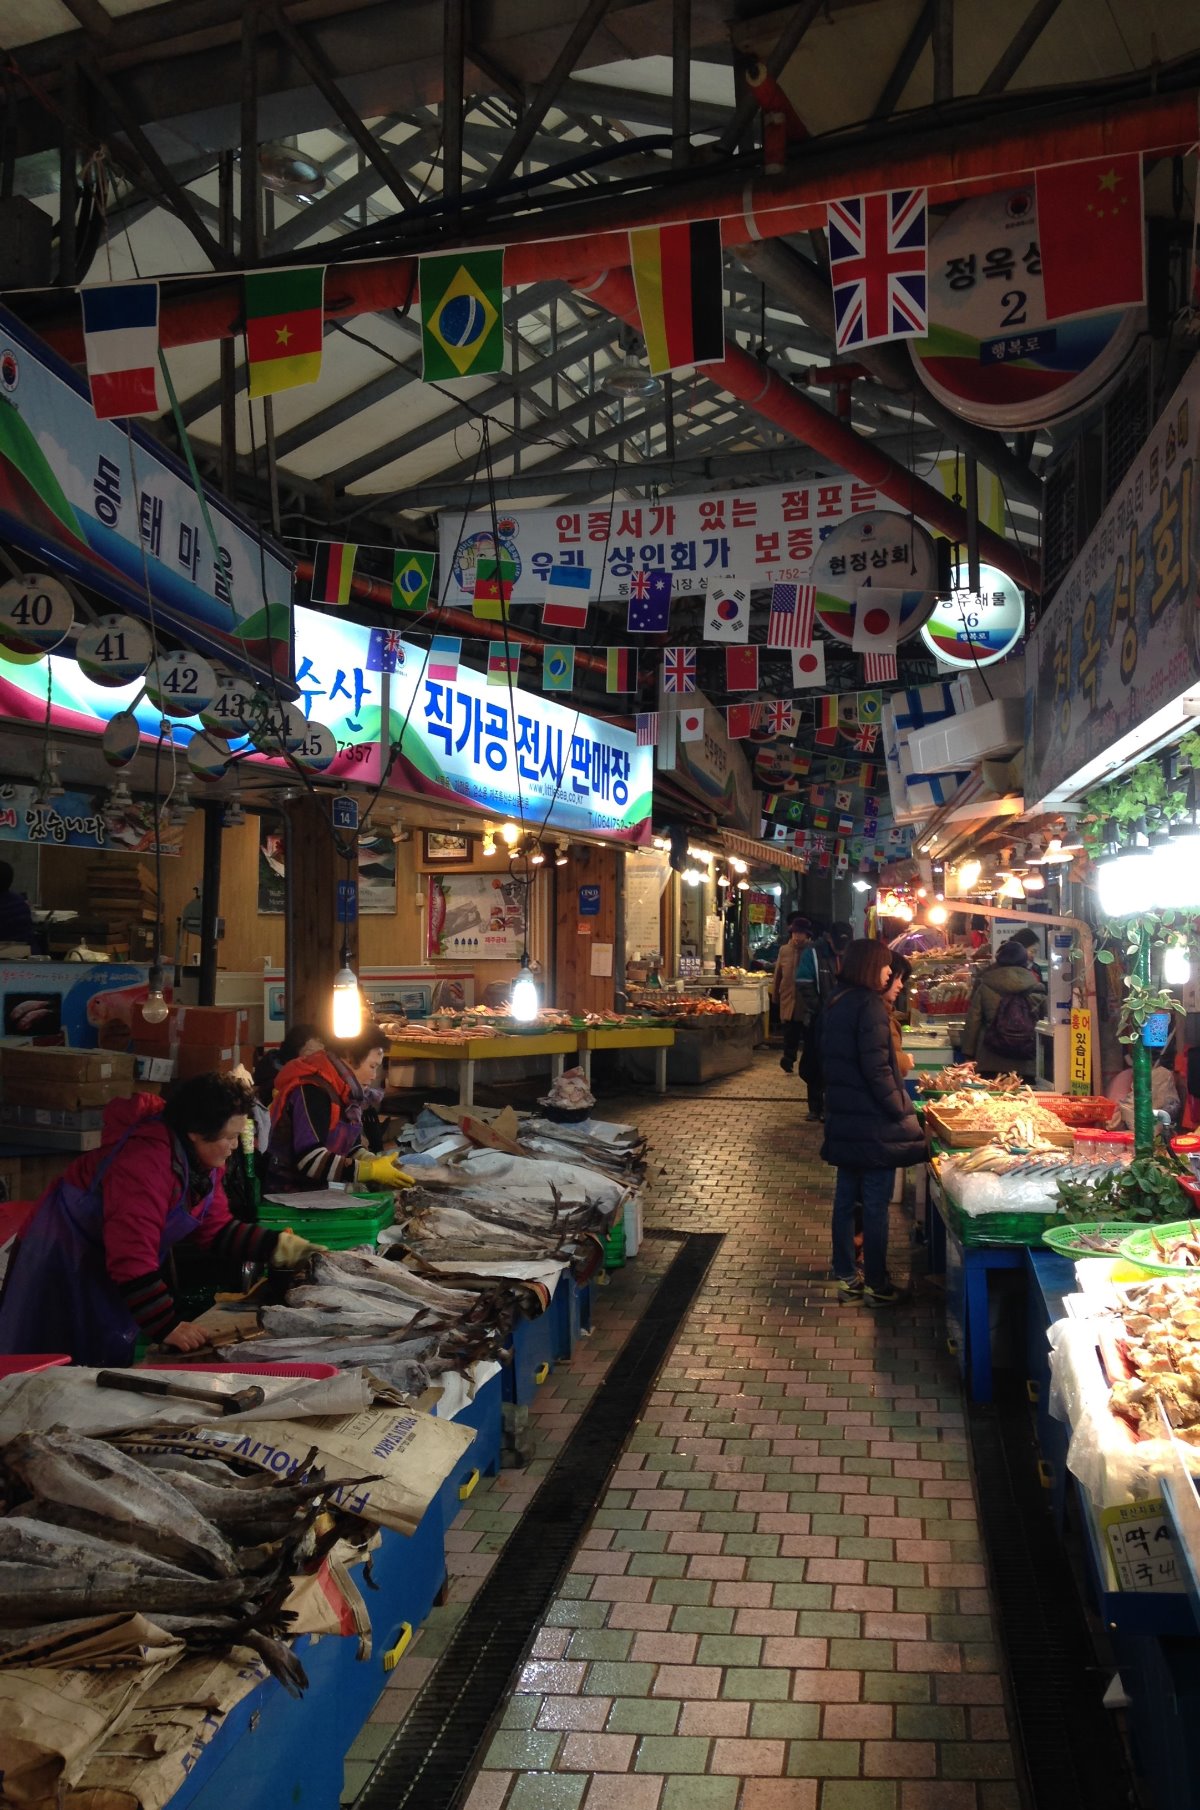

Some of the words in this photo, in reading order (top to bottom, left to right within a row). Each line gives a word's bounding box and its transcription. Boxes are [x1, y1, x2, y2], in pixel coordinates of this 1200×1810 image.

[1000, 290, 1026, 328] 2
[990, 335, 1041, 360] 행복로
[555, 506, 676, 543] 인증서가
[698, 497, 758, 531] 있는
[781, 482, 878, 523] 점포는
[607, 537, 731, 577] 상인회가
[828, 545, 910, 575] 현정상회
[10, 594, 52, 626] 40
[1052, 458, 1193, 737] 정옥상회
[94, 632, 130, 663] 41
[162, 667, 199, 695] 42
[295, 655, 373, 733] 수산
[213, 693, 245, 718] 43
[297, 734, 323, 756] 45
[423, 679, 509, 772] 직가공
[516, 714, 563, 790] 전시
[570, 733, 631, 806] 판매장
[25, 808, 106, 845] 있습니다
[339, 811, 351, 825] 14
[1075, 1032, 1087, 1081] 있습니다
[233, 1436, 309, 1485] ROLIV
[371, 1432, 400, 1460] STARKA
